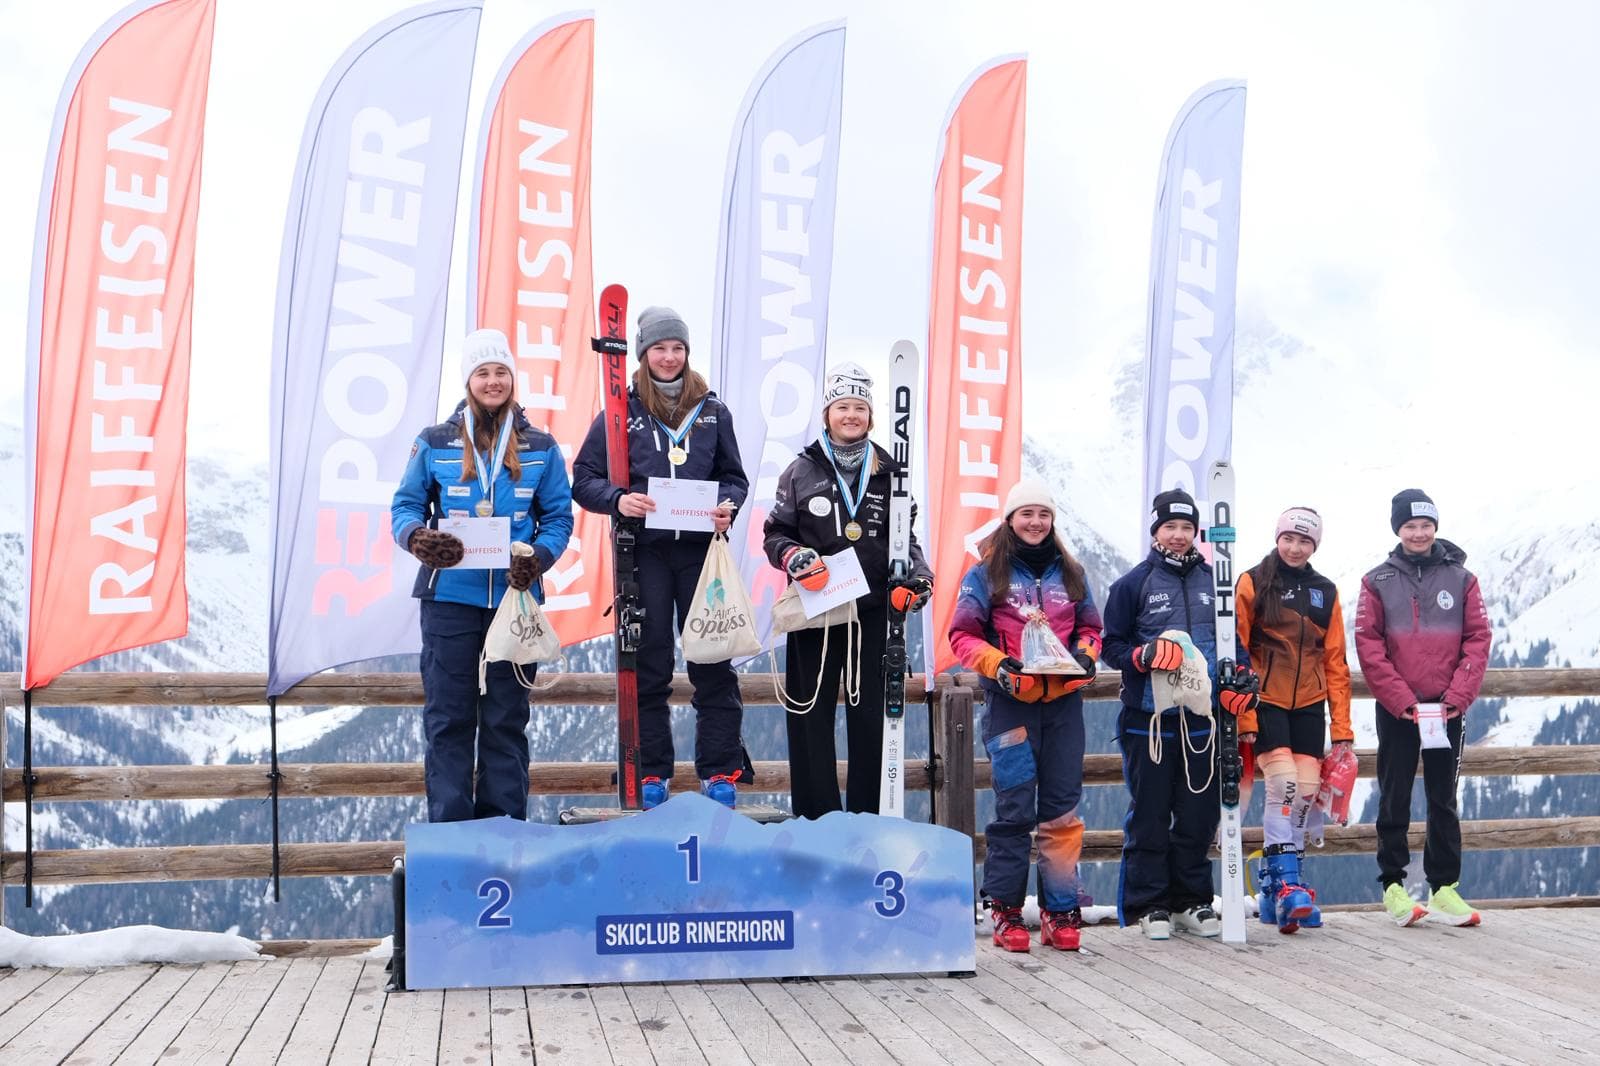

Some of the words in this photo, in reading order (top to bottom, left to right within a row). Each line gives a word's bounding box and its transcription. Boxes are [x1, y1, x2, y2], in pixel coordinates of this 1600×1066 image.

[89, 97, 172, 615] RAIFFEISEN
[311, 106, 431, 616] REPOWER
[959, 153, 1008, 561] AIFFEISEN
[892, 385, 911, 498] HEAD
[671, 508, 709, 517] RAIFFEISEN
[1214, 501, 1233, 617] HEAD
[823, 577, 859, 597] RAIFFEISEN
[1149, 592, 1169, 604] Beta
[677, 835, 700, 883] 1
[477, 878, 512, 928] 2
[874, 869, 907, 919] 3
[605, 922, 680, 946] SKICLUB
[686, 919, 785, 944] RINERHORN
